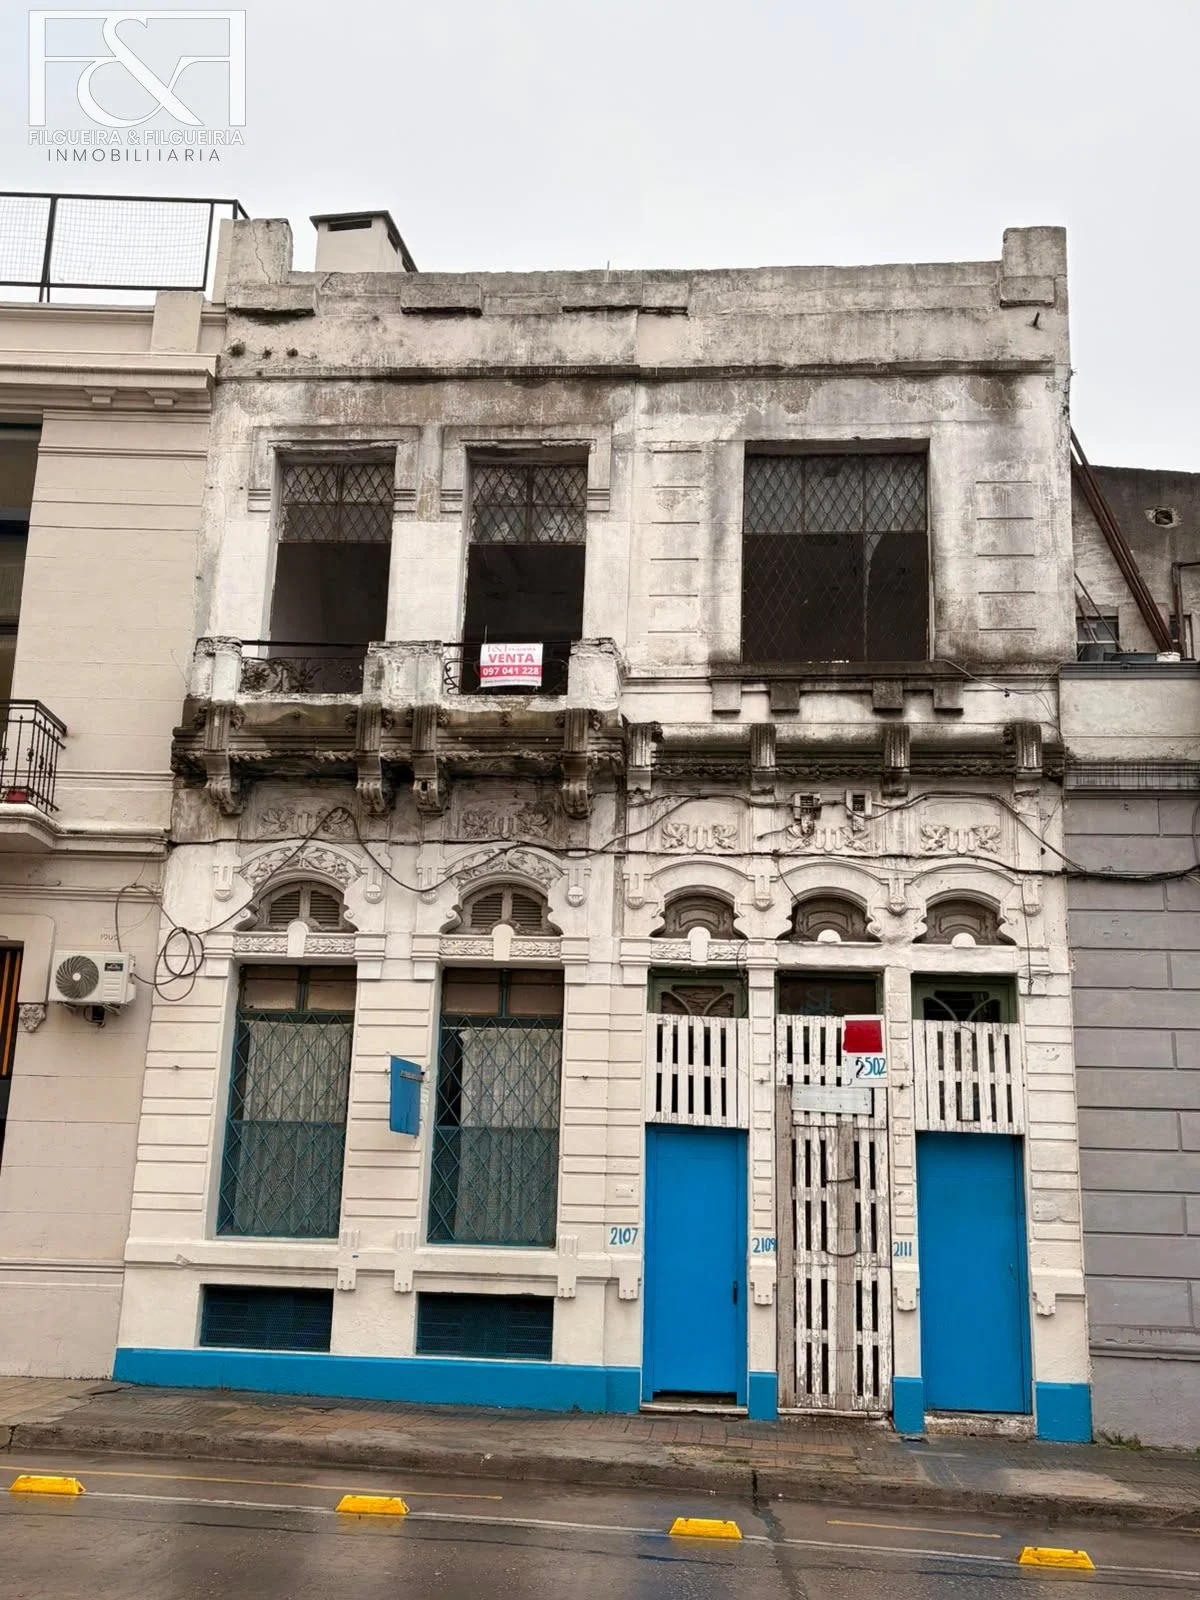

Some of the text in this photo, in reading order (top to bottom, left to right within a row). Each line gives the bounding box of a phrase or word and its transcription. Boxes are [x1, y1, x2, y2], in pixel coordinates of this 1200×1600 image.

[488, 653, 535, 663] VENTA
[482, 667, 499, 676] 097
[502, 666, 519, 675] 041
[609, 1226, 638, 1245] 2107
[752, 1237, 777, 1253] 2109
[893, 1241, 912, 1257] 2111
